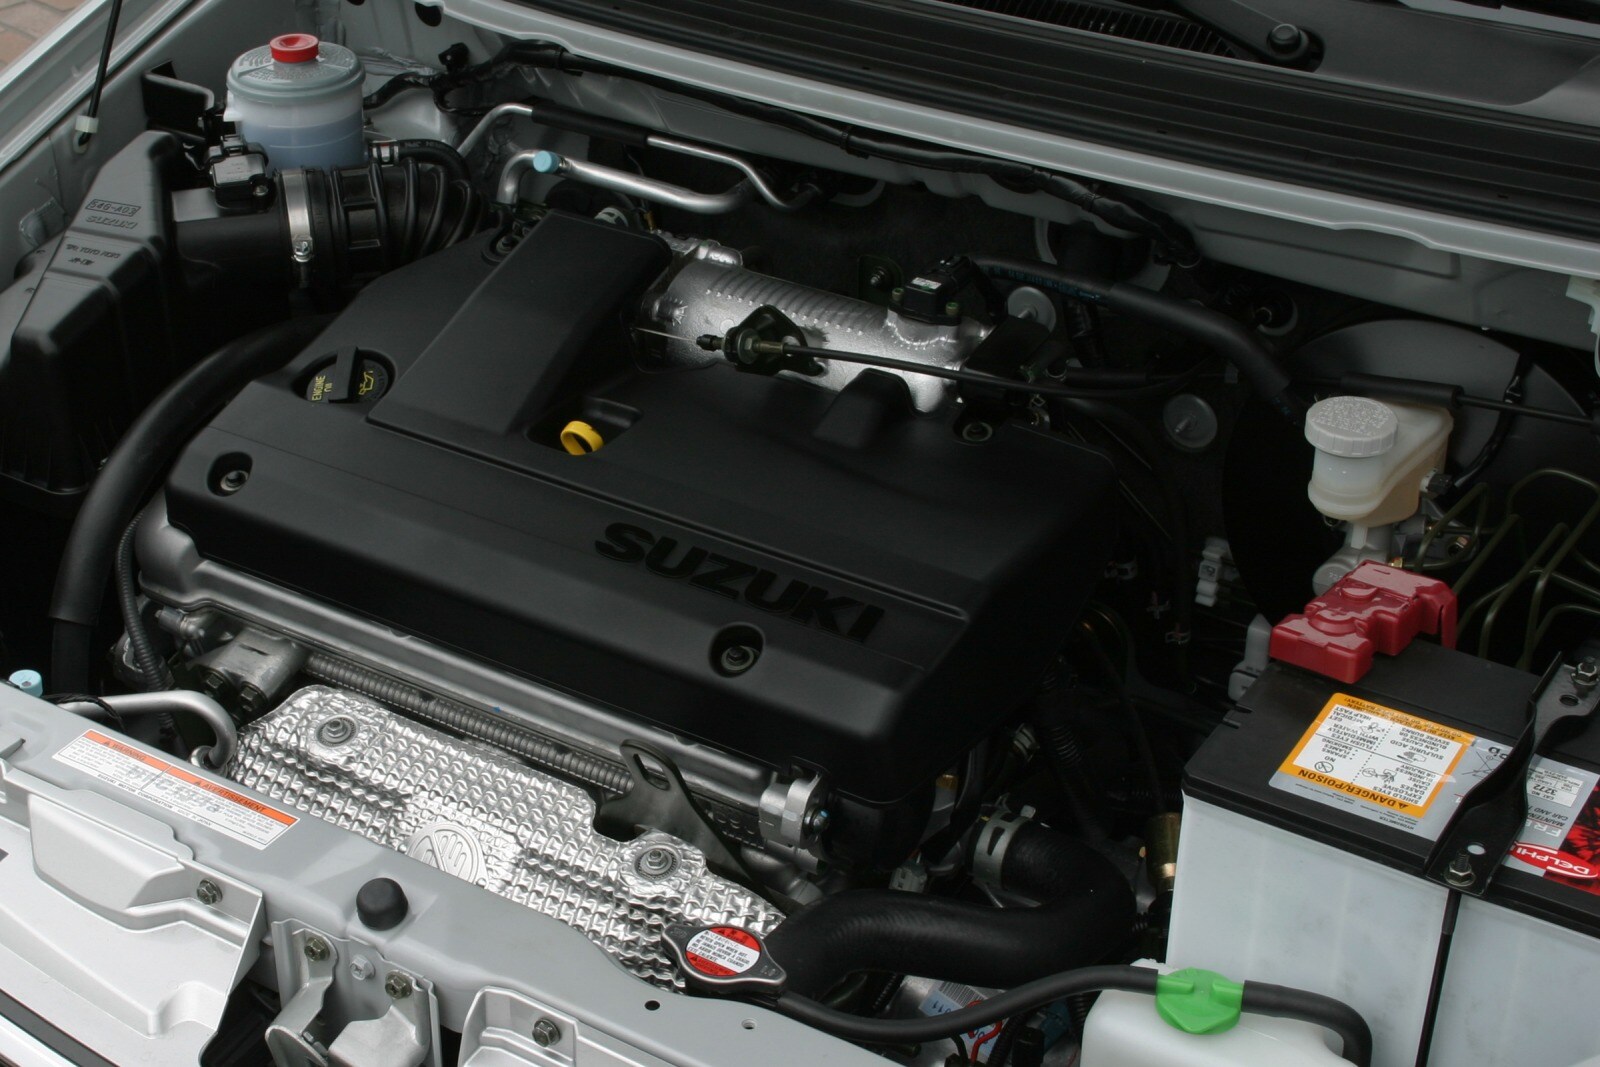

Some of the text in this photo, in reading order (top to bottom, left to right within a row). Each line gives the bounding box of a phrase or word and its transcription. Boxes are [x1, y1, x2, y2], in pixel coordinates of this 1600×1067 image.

[86, 216, 138, 230] SUZUKI
[312, 376, 326, 400] ENGINE
[595, 522, 885, 644] SUZUKI
[1328, 727, 1376, 745] IMMEDIATELY
[1350, 739, 1373, 750] FLUSH
[1401, 738, 1424, 747] CAUSE
[112, 743, 146, 760] WARNING
[1390, 739, 1444, 760] SULFURIC ACID
[97, 774, 116, 784] SUZUKI
[118, 783, 136, 793] MOTOR
[138, 791, 173, 809] CORPORATION
[1298, 769, 1396, 806] DANGER/POISON
[1383, 784, 1422, 800] EXPLOSIVE
[1400, 784, 1425, 795] GASES
[1533, 784, 1558, 796] 3272
[203, 784, 265, 812] AVERTISSEMENT
[1533, 806, 1551, 816] AND
[1551, 812, 1568, 822] CAR
[1516, 847, 1590, 875] DELPHI
